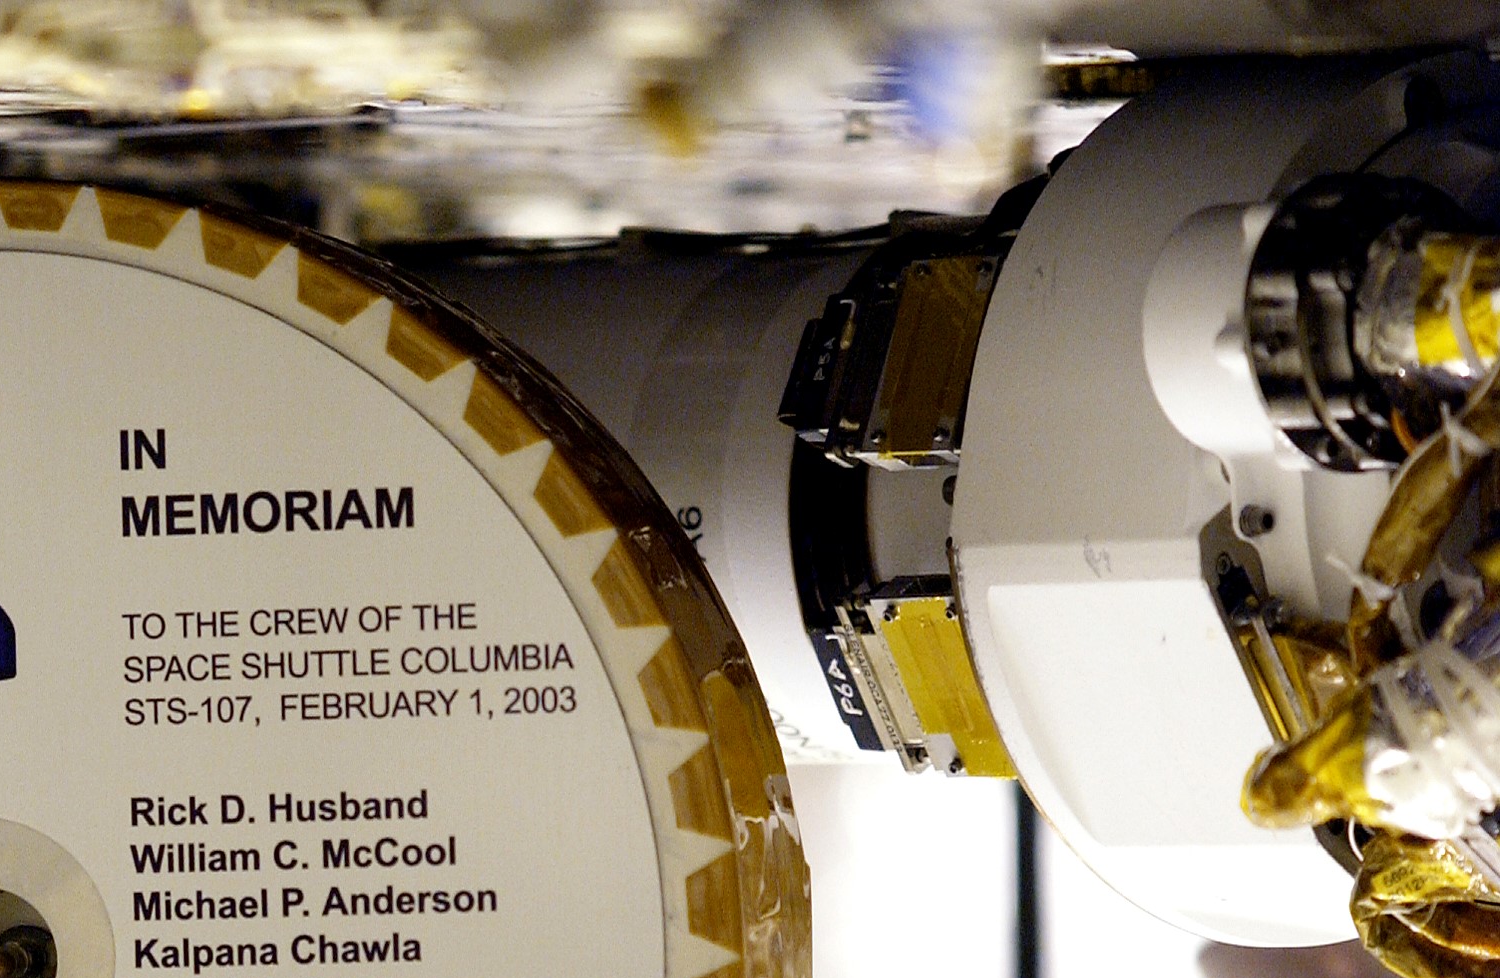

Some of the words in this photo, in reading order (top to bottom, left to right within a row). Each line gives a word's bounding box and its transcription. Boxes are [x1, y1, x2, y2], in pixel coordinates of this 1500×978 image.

[120, 428, 166, 471] IN
[121, 486, 414, 538] MEMORIAM
[121, 612, 166, 640] TO
[175, 610, 240, 639] THE
[249, 607, 349, 637] CREW
[358, 605, 402, 633] OF
[412, 603, 477, 631] THE
[124, 653, 231, 684] SPACE
[241, 648, 390, 680] SHUTTLE
[400, 643, 574, 675] COLUMBIA
[125, 695, 260, 726] STS-107,
[280, 689, 458, 721] FEBRUARY
[470, 689, 493, 719] 1,
[504, 686, 577, 714] 2003
[828, 658, 863, 717] P6A
[130, 796, 208, 827] Rick
[220, 794, 255, 824] D.
[269, 789, 428, 823] Husband
[129, 842, 260, 874] William
[273, 840, 309, 870] C.
[322, 836, 456, 869] McCool
[133, 888, 268, 921] Michael
[282, 887, 310, 917] P.
[321, 885, 497, 916] Anderson
[134, 938, 279, 975] Kalpana
[291, 932, 421, 965] Chawla
